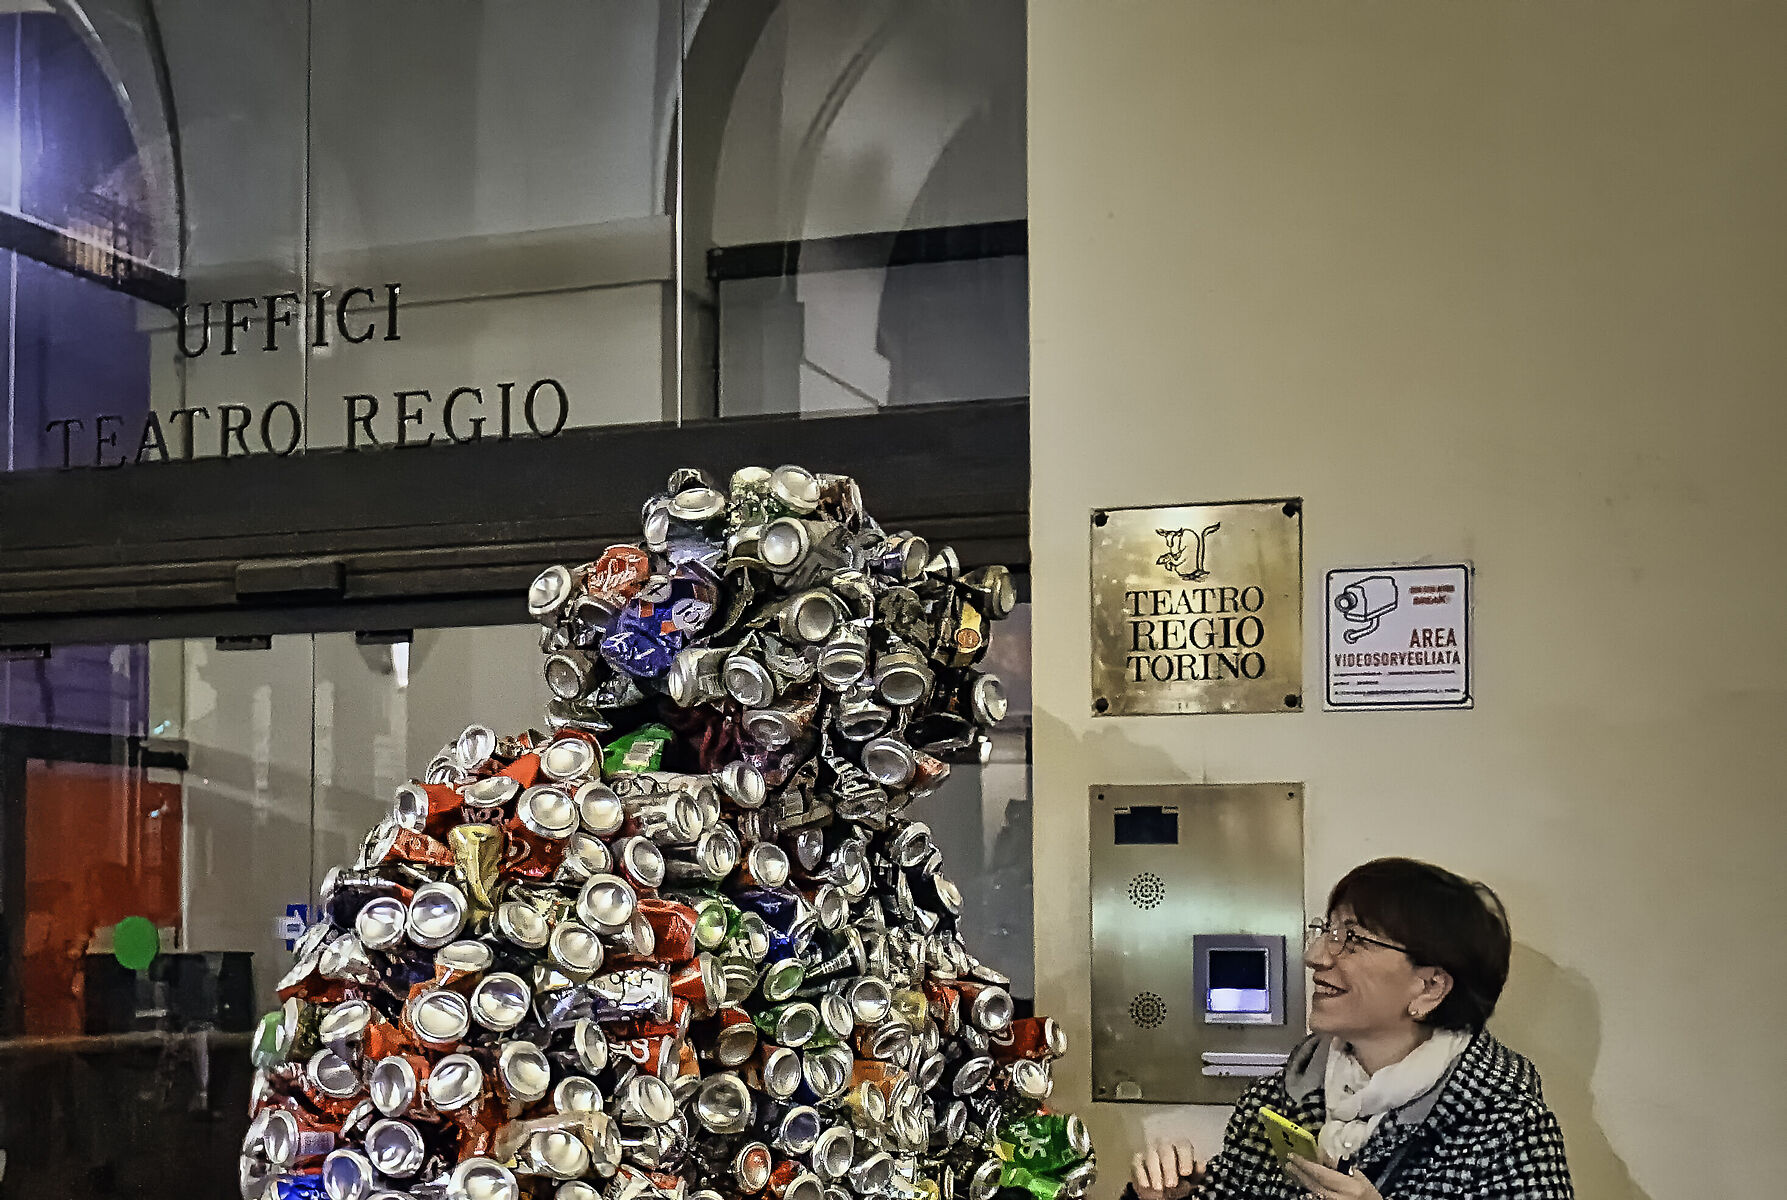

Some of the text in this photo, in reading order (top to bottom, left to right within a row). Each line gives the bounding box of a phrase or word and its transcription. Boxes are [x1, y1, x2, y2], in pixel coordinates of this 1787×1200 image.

[175, 283, 401, 358] UFFICI
[46, 378, 569, 471] TEATRO REGIO
[1125, 586, 1265, 617] TEATRO
[1127, 615, 1265, 652] REGIO
[1409, 627, 1458, 648] AREA
[1126, 652, 1266, 682] TORINO
[1334, 651, 1461, 667] VIDEOSORVEGLIATA
